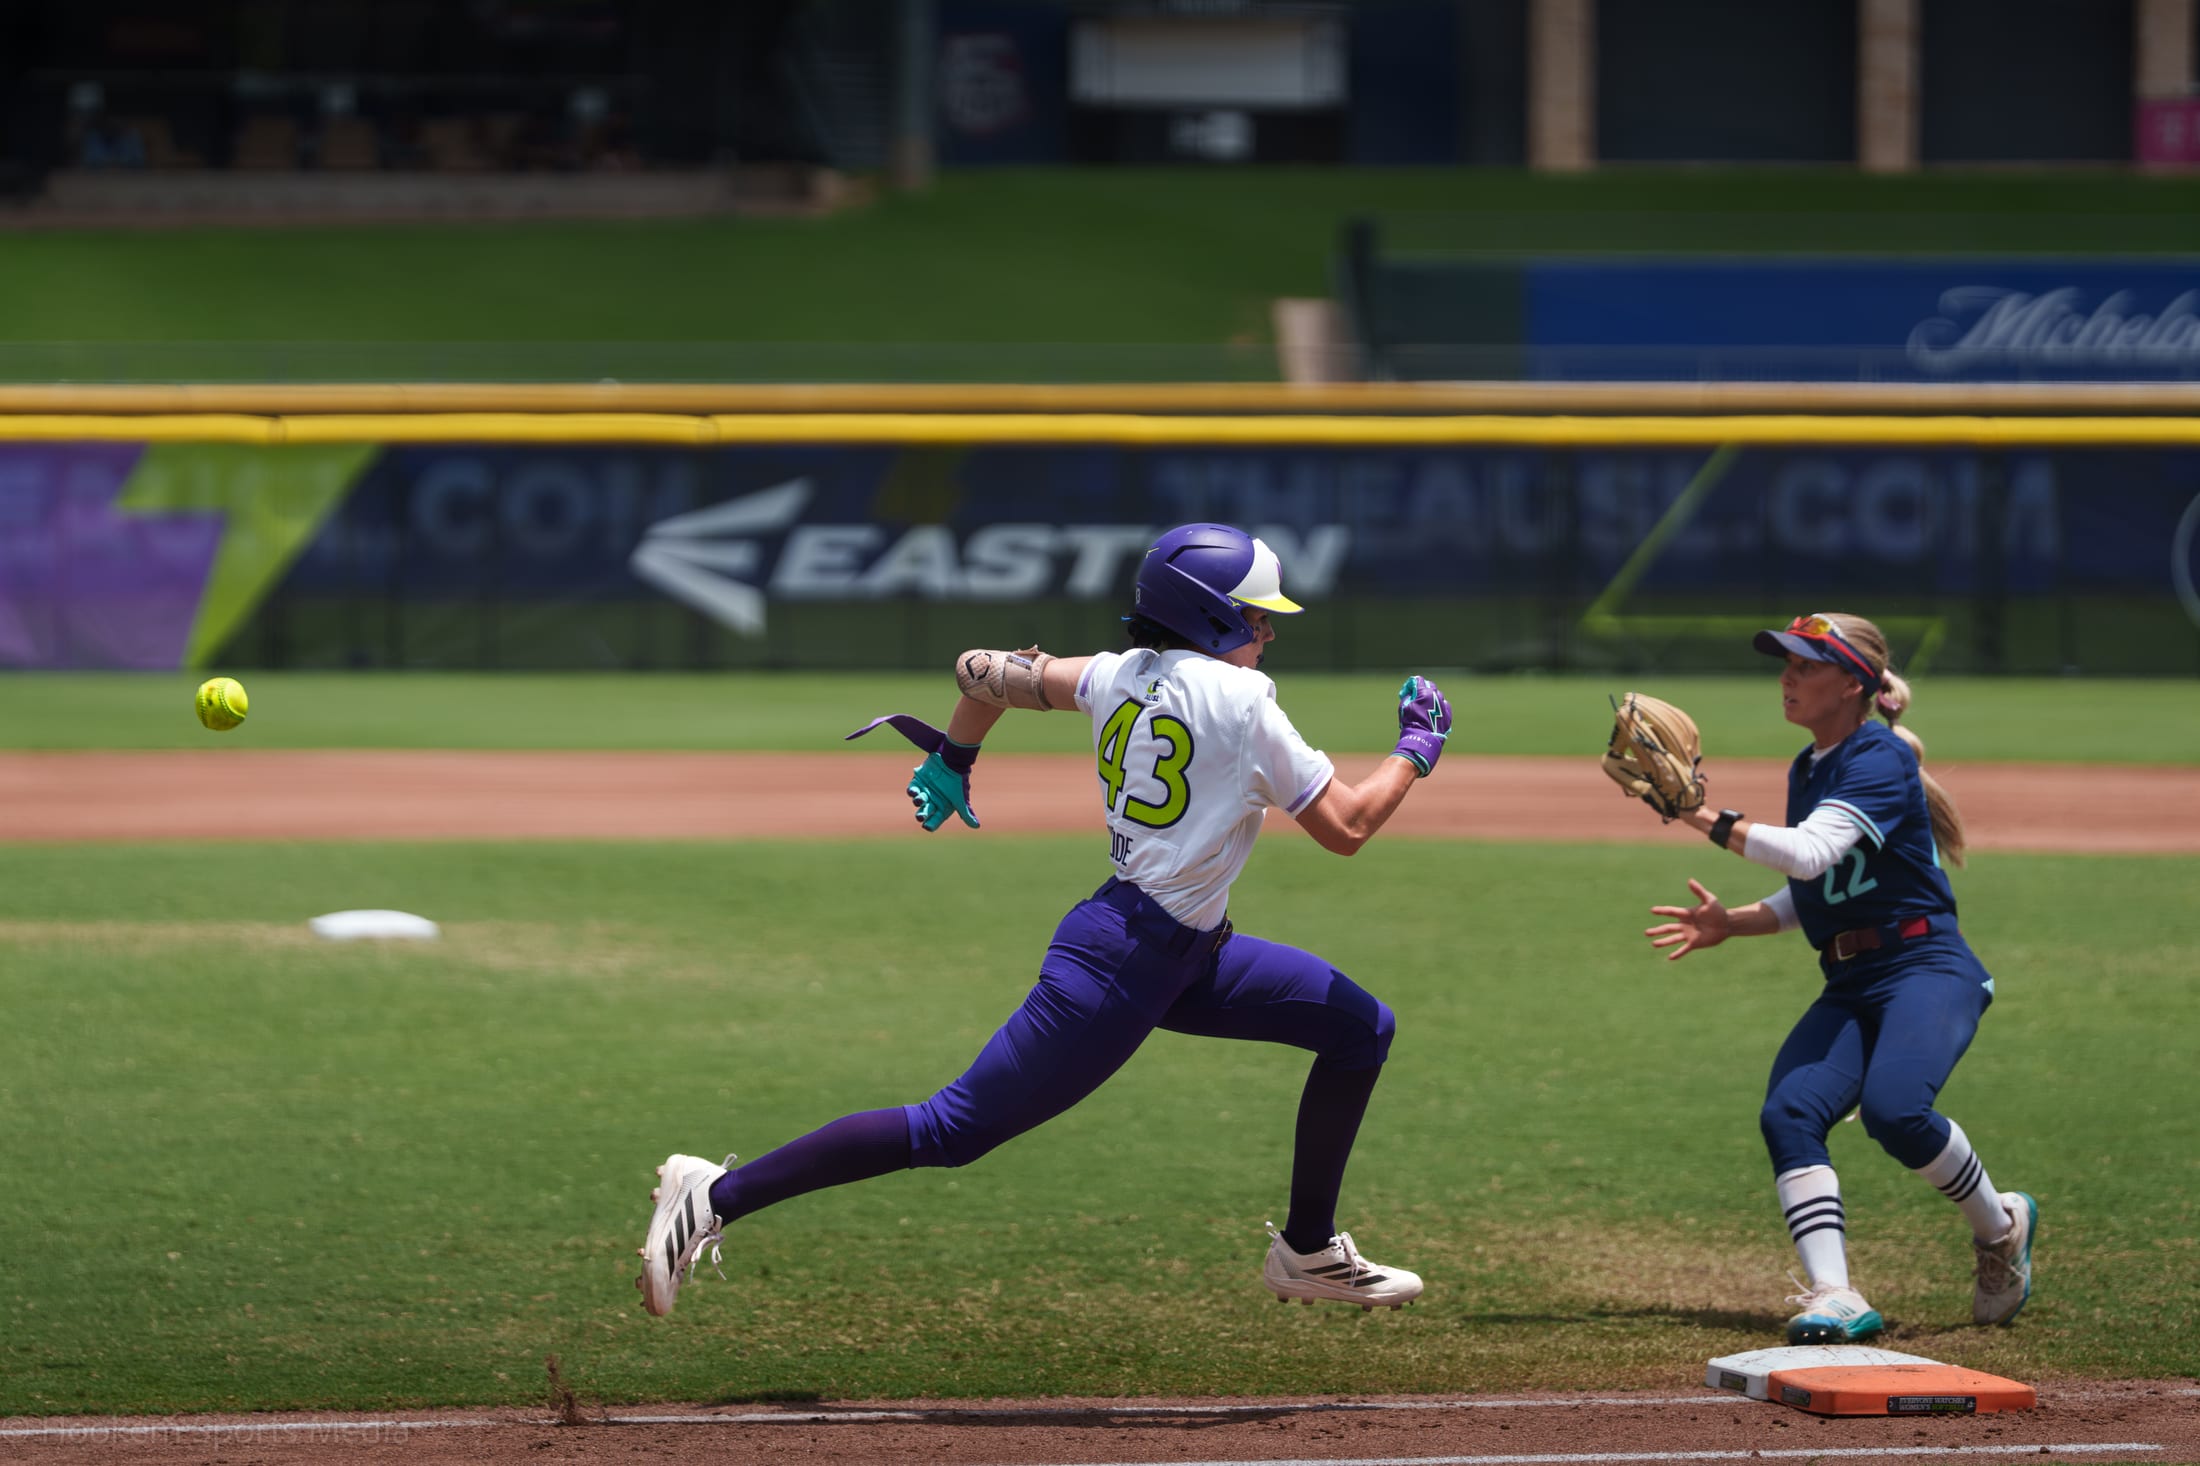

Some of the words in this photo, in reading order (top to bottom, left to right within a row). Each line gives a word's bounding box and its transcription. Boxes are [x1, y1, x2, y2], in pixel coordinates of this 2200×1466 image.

[770, 523, 1349, 597] EASTN
[1097, 697, 1195, 829] 43
[1823, 847, 1878, 904] 22
